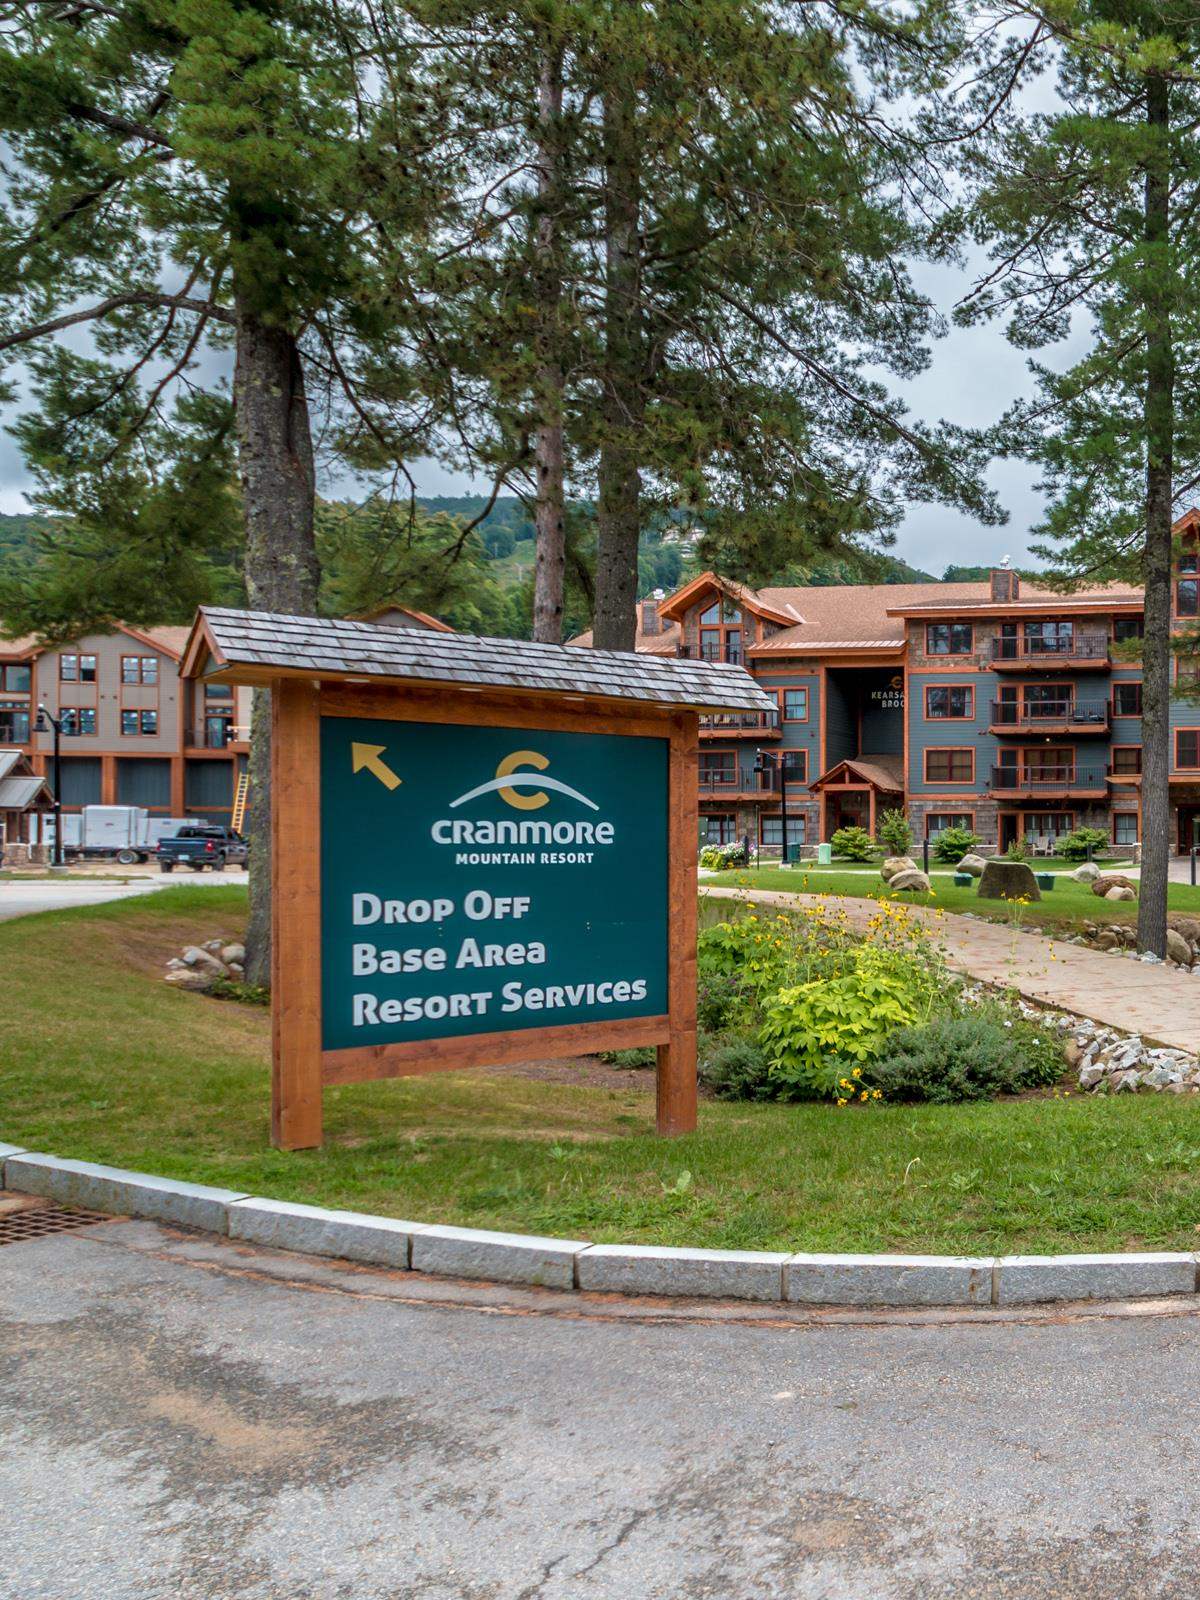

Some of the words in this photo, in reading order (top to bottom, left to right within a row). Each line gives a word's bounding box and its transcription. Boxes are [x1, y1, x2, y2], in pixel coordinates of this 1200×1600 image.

[455, 852, 535, 865] MOUNTAIN
[540, 851, 594, 864] RESORT
[352, 942, 448, 977] Base
